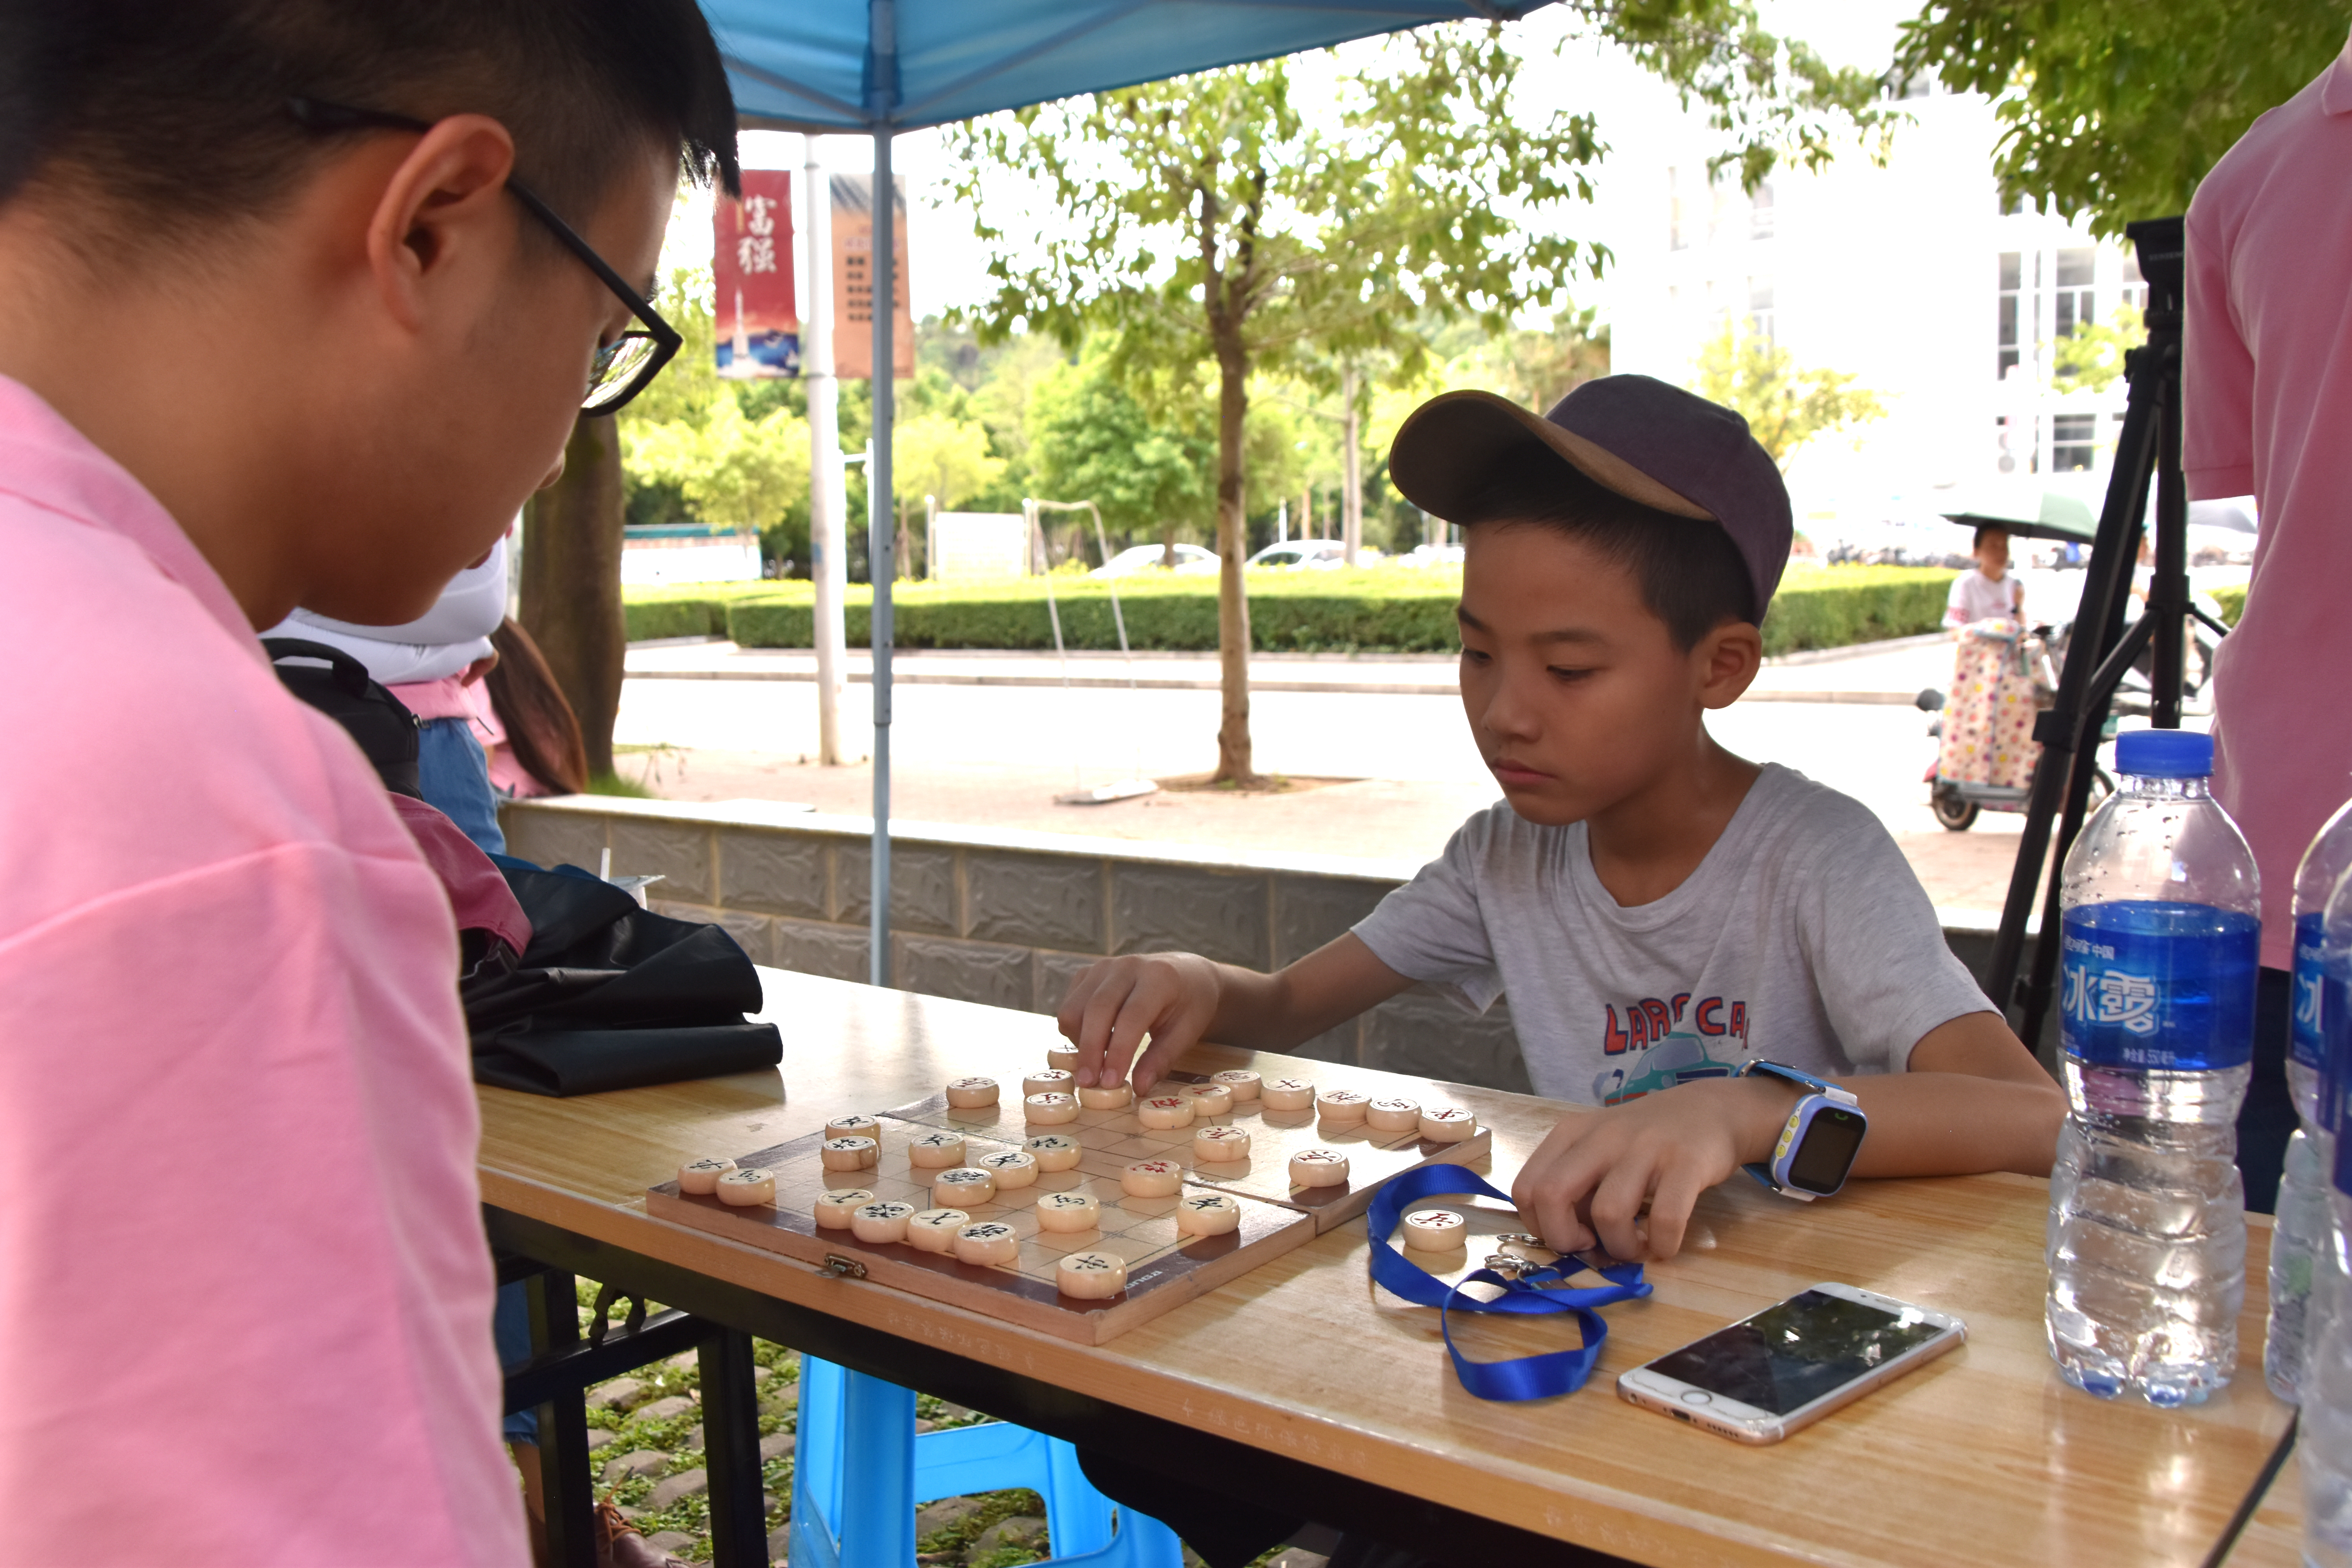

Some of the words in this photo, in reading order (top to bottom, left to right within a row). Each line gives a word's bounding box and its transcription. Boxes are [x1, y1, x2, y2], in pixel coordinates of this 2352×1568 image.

[737, 194, 778, 276] 富强
[1604, 992, 1749, 1056] LARCA
[2062, 964, 2155, 1033] 冰露
[1414, 1213, 1454, 1226] 兵
